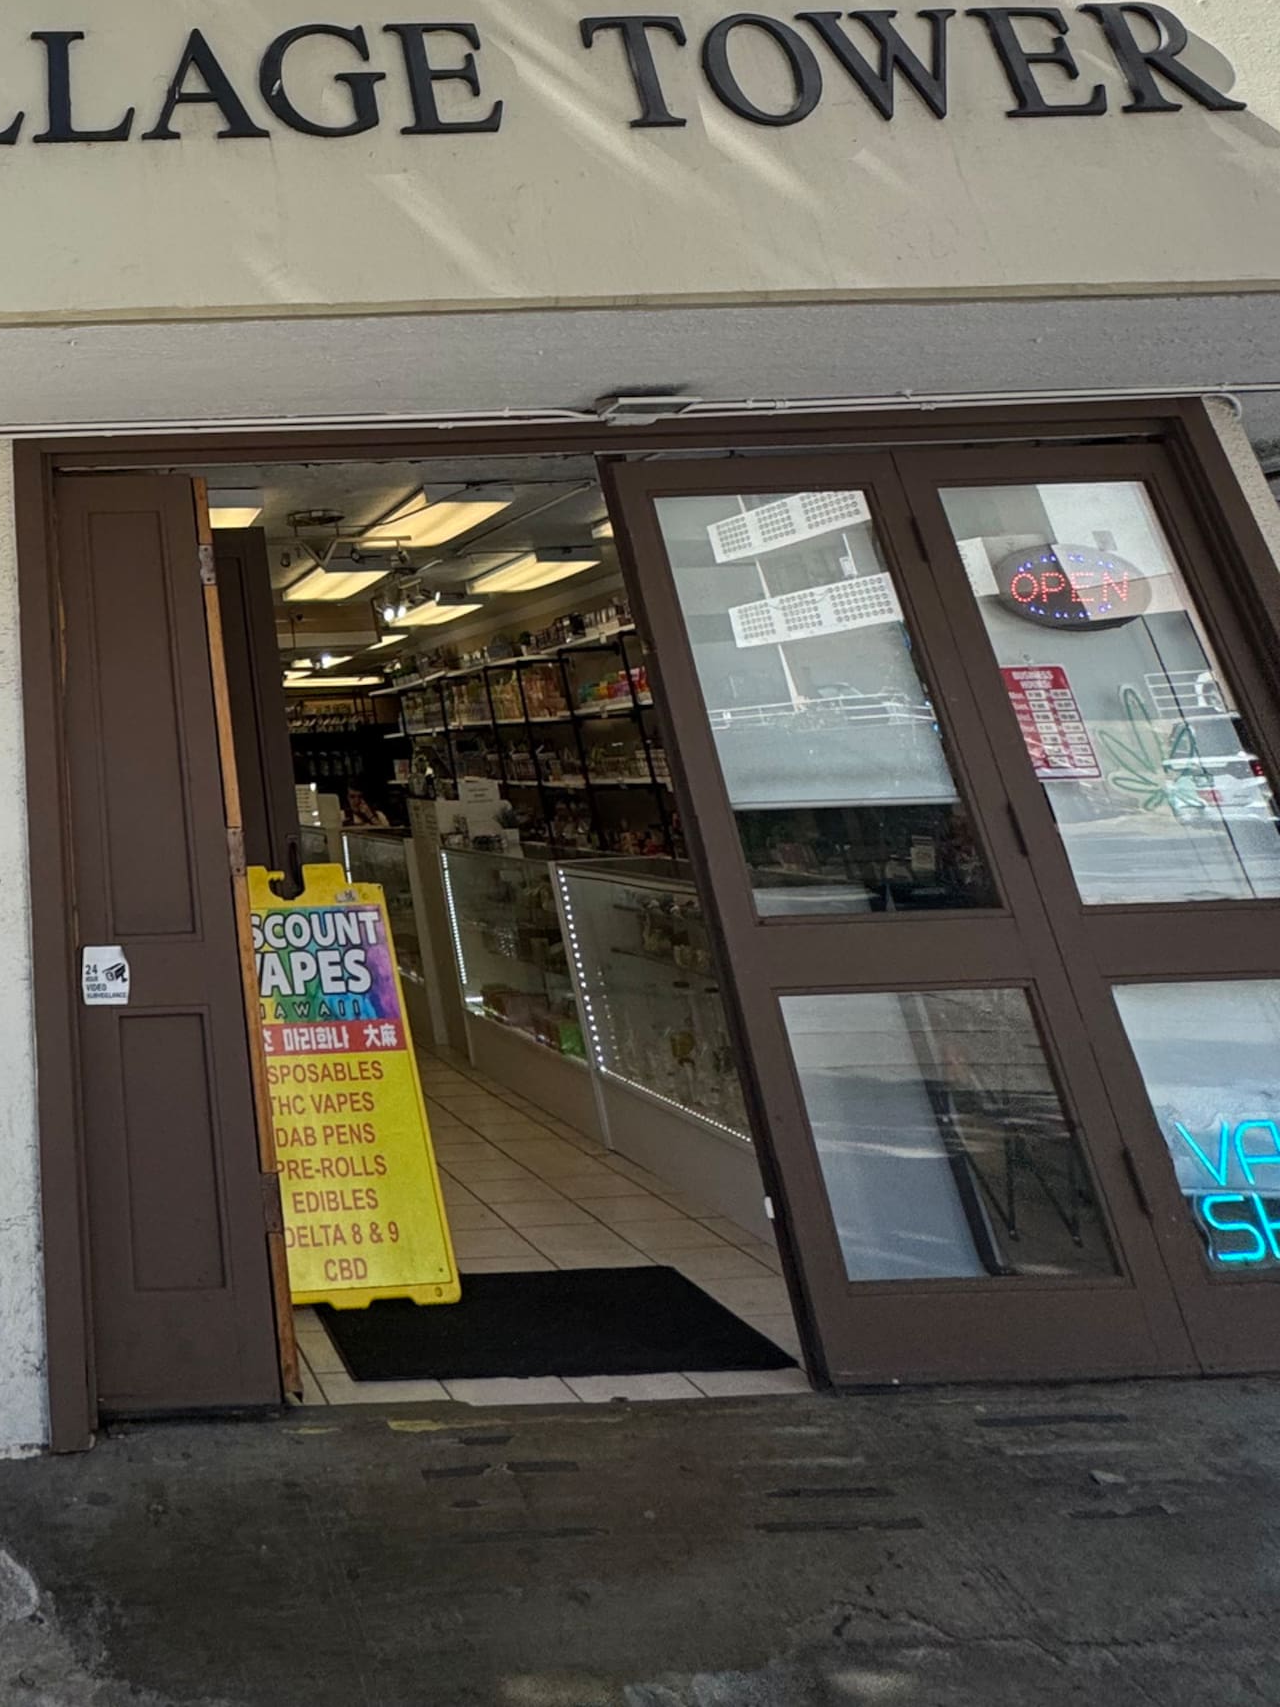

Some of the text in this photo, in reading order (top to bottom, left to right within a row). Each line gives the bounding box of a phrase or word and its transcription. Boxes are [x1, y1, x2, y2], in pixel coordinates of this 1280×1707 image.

[579, 1, 1247, 128] TOWER
[1011, 571, 1129, 603] OPEN
[251, 910, 379, 949] SCOUNT
[85, 964, 98, 975] 24
[255, 948, 373, 997] APES
[86, 983, 107, 992] VIDEO
[362, 1022, 398, 1048] 大麻
[266, 1060, 384, 1085] SPOSABLES
[270, 1091, 376, 1117] THC VAPES
[275, 1122, 376, 1148] DAB PENS
[276, 1154, 388, 1181] PRE-ROLLS
[292, 1188, 379, 1214] EDIBLES
[285, 1220, 400, 1248] DELTA 8 & 9
[324, 1257, 368, 1282] CBD
